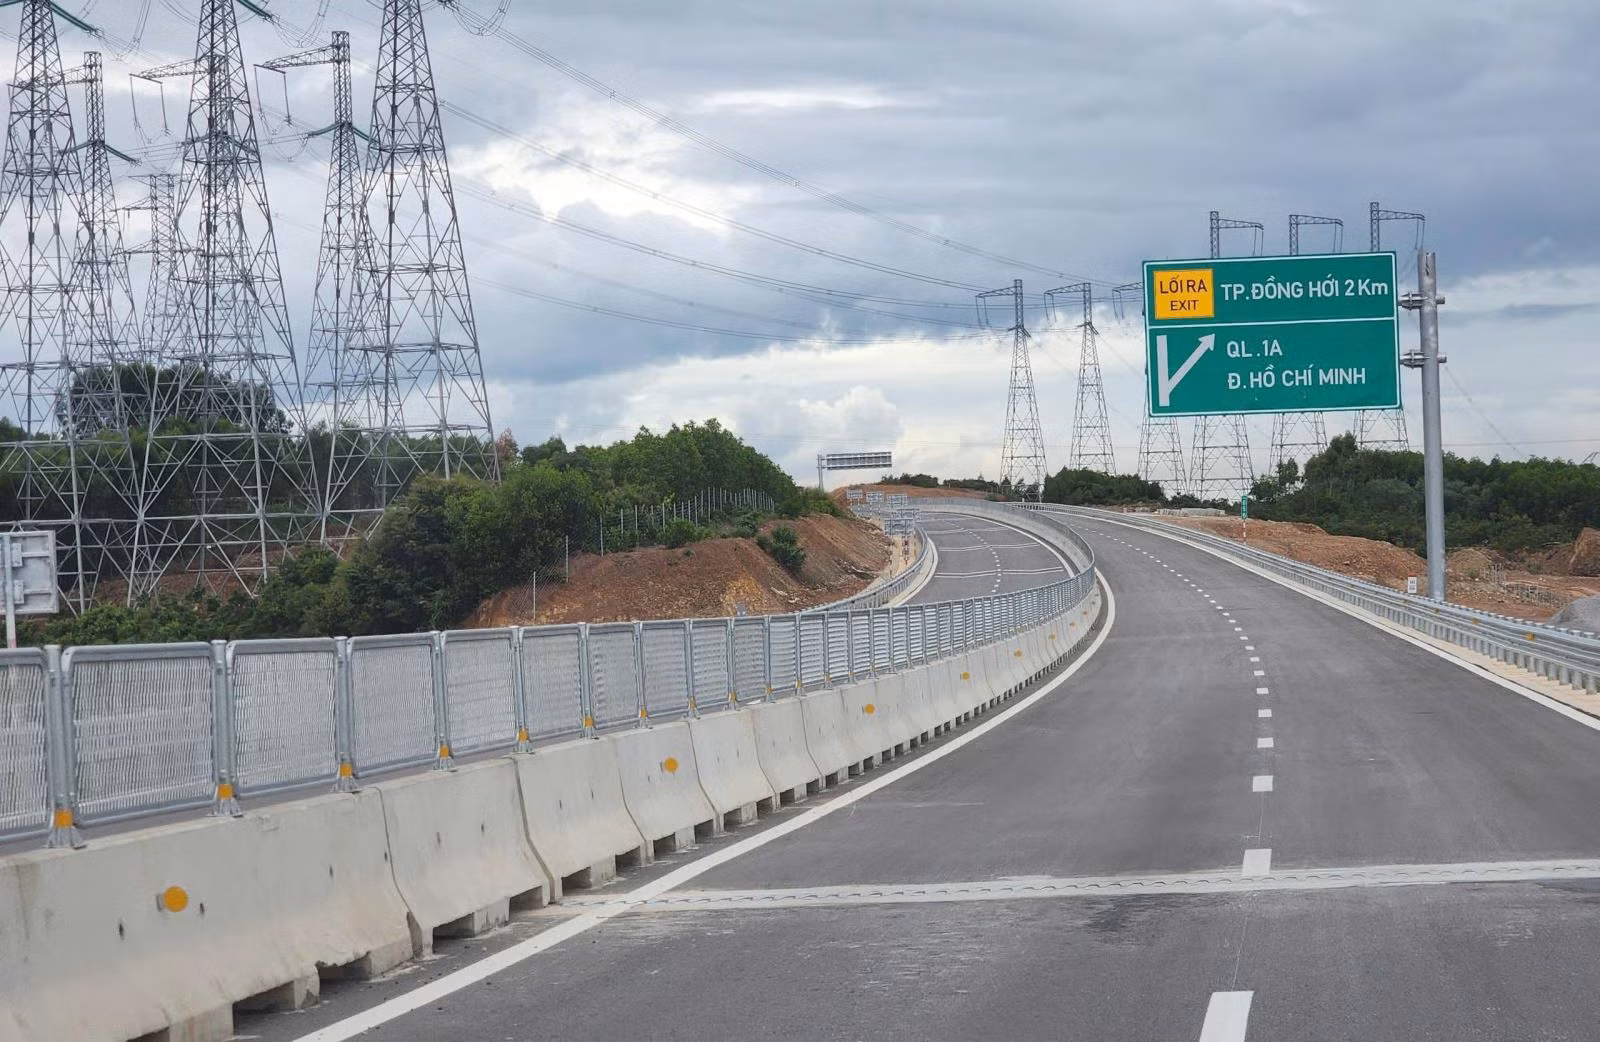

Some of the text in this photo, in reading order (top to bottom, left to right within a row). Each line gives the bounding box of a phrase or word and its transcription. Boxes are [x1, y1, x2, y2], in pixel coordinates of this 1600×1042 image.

[1308, 273, 1340, 298] HỚI
[1170, 299, 1199, 311] EXIT
[1281, 363, 1314, 387] CHÍ
[1318, 367, 1366, 386] MINH
